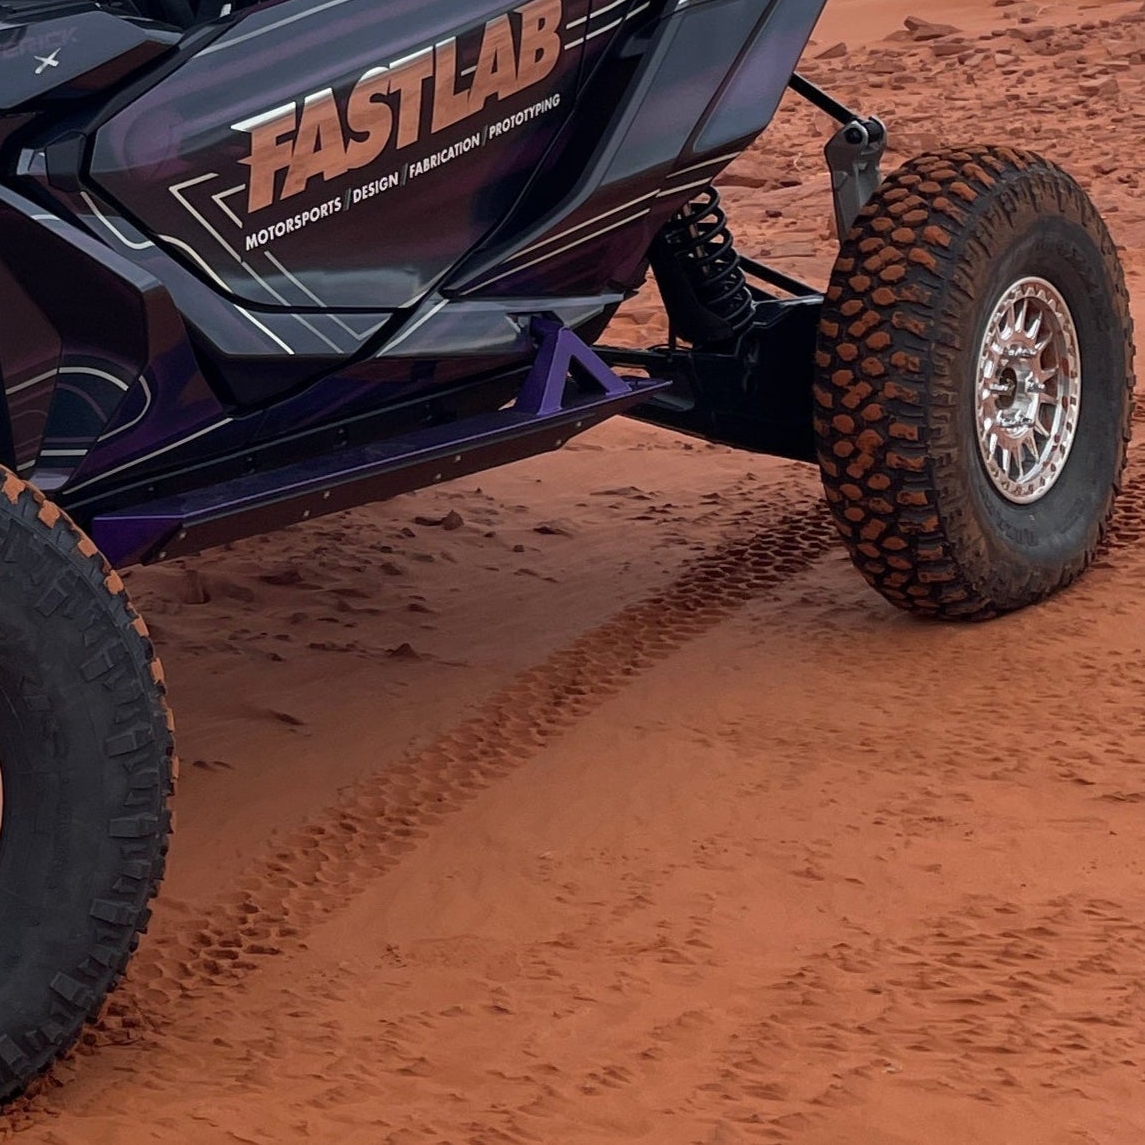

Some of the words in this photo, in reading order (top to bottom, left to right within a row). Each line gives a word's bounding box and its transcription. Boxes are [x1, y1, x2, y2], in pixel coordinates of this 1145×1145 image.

[245, 196, 342, 251] MOTORSPORTS
[352, 171, 399, 204] DESIGN
[408, 132, 481, 179] FABRICATION
[488, 93, 562, 140] PROTOTYPING
